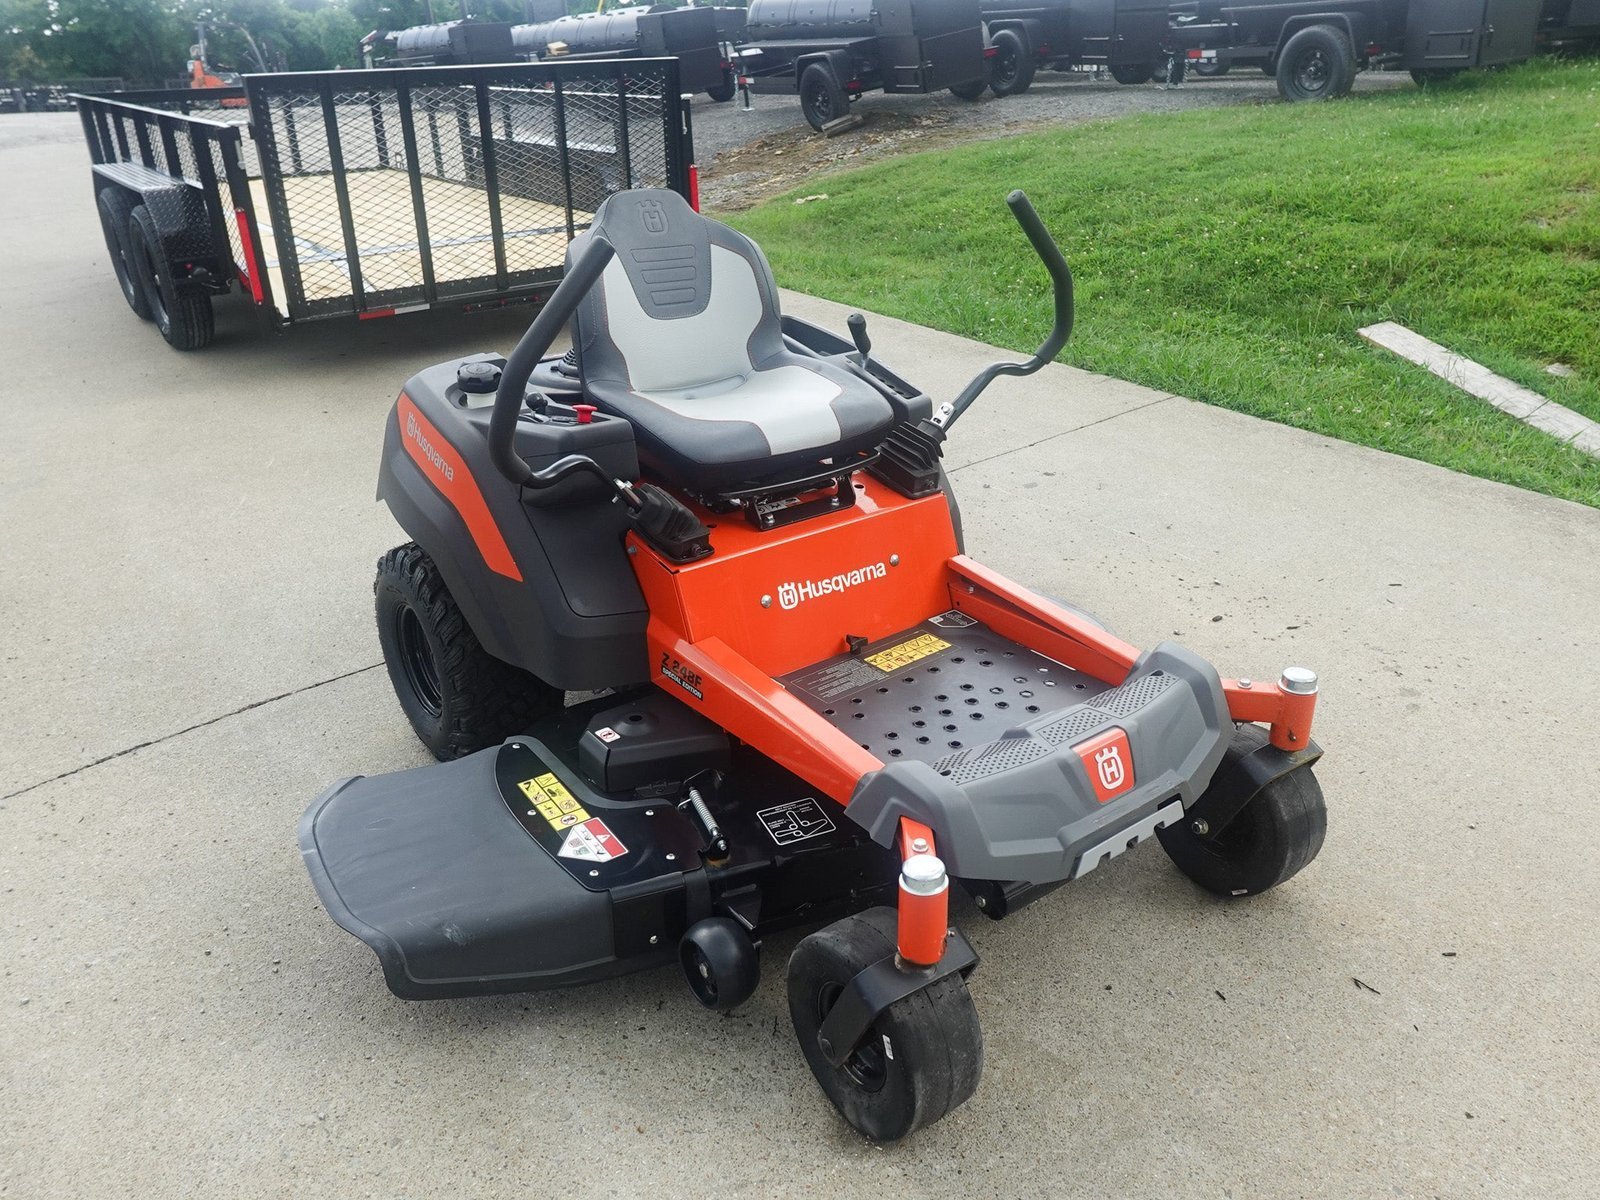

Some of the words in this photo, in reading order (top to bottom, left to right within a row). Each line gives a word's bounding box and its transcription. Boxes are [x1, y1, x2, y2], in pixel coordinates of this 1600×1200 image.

[414, 423, 454, 481] Husqvarna
[798, 562, 887, 602] Husqvarna
[662, 652, 670, 667] Z
[672, 660, 702, 687] 248F
[662, 667, 682, 685] SPECIAL
[682, 681, 702, 699] EDITION
